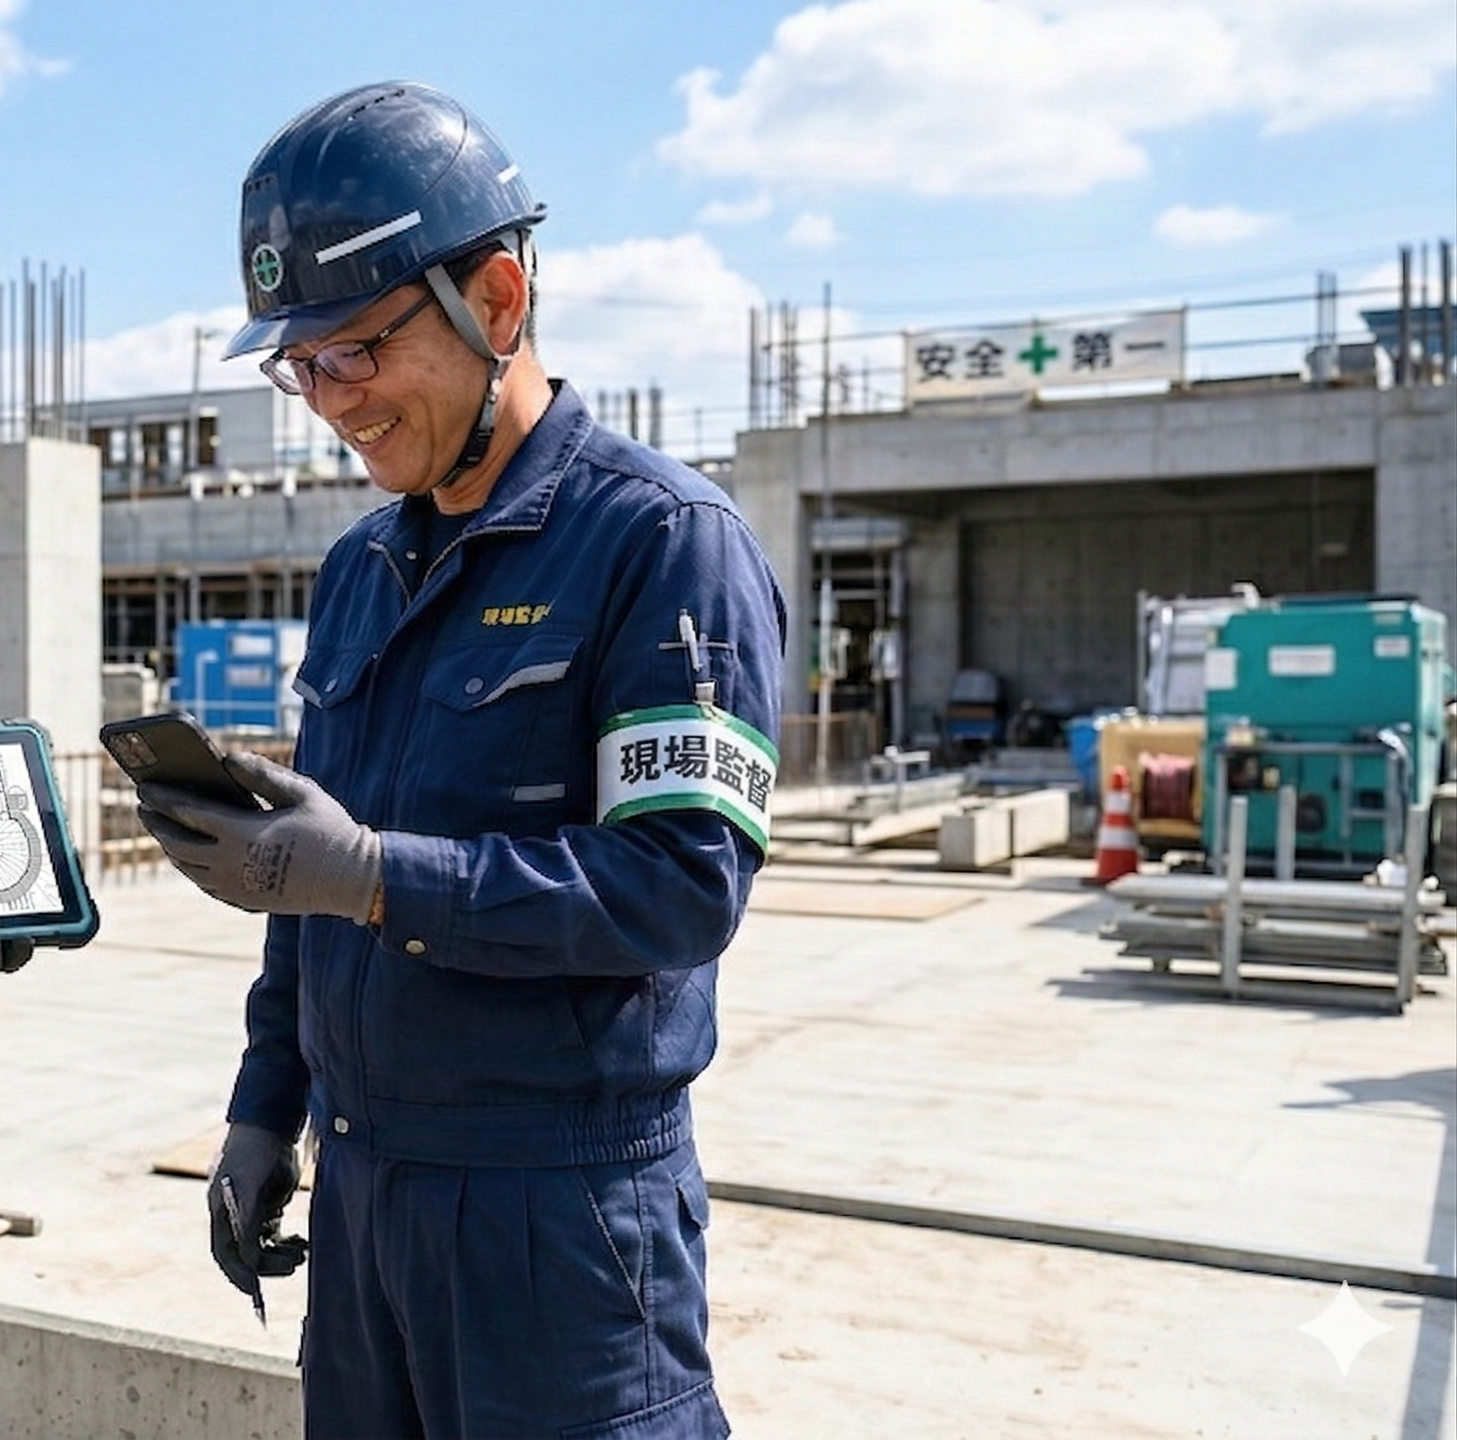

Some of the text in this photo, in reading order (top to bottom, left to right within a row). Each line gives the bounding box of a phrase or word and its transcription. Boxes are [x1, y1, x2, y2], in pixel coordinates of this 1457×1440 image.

[916, 332, 1165, 383] 安全 第一
[620, 735, 772, 813] 現場監督
